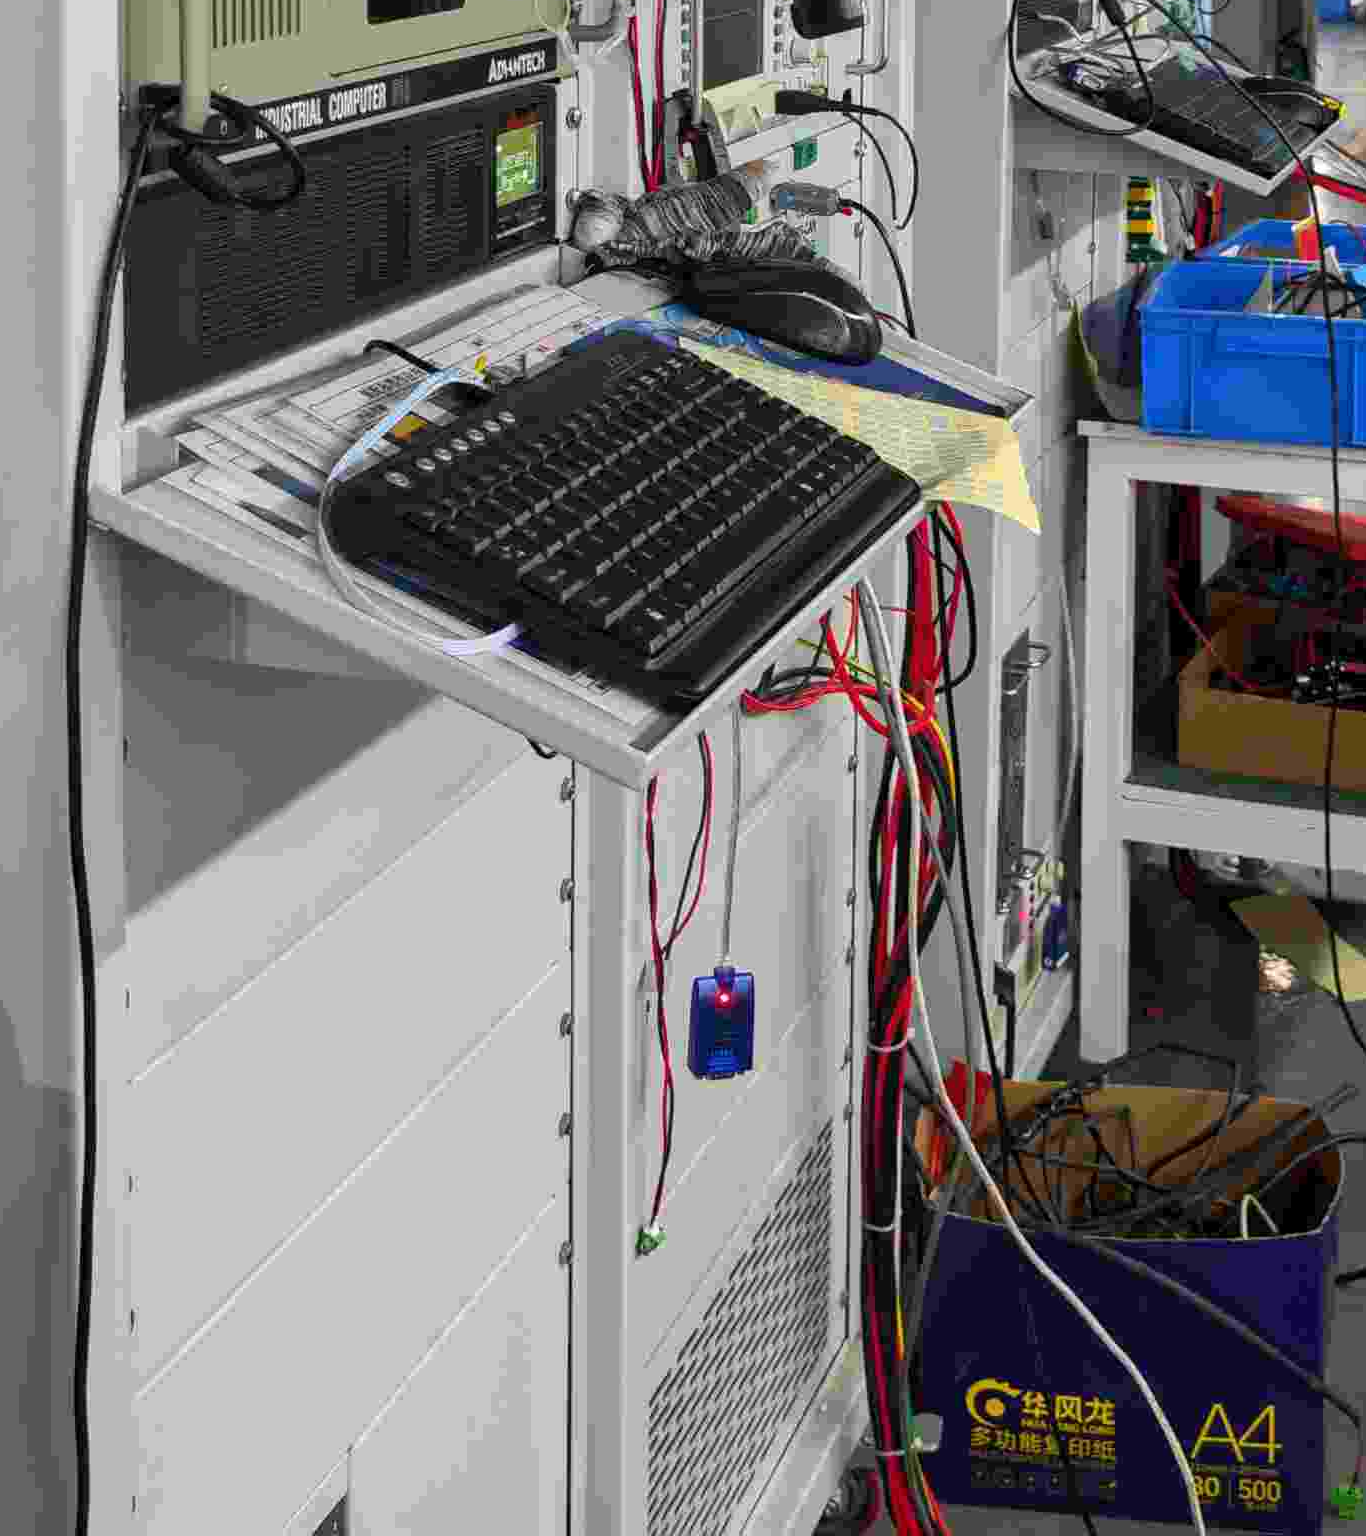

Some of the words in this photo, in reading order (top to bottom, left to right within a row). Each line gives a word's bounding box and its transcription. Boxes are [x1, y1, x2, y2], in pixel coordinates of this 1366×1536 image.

[487, 49, 546, 83] ADVANTECH
[328, 81, 387, 122] COMPUTER
[1019, 1392, 1116, 1425] 华风龙
[1190, 1402, 1284, 1464] A4
[1238, 1478, 1282, 1503] 500
